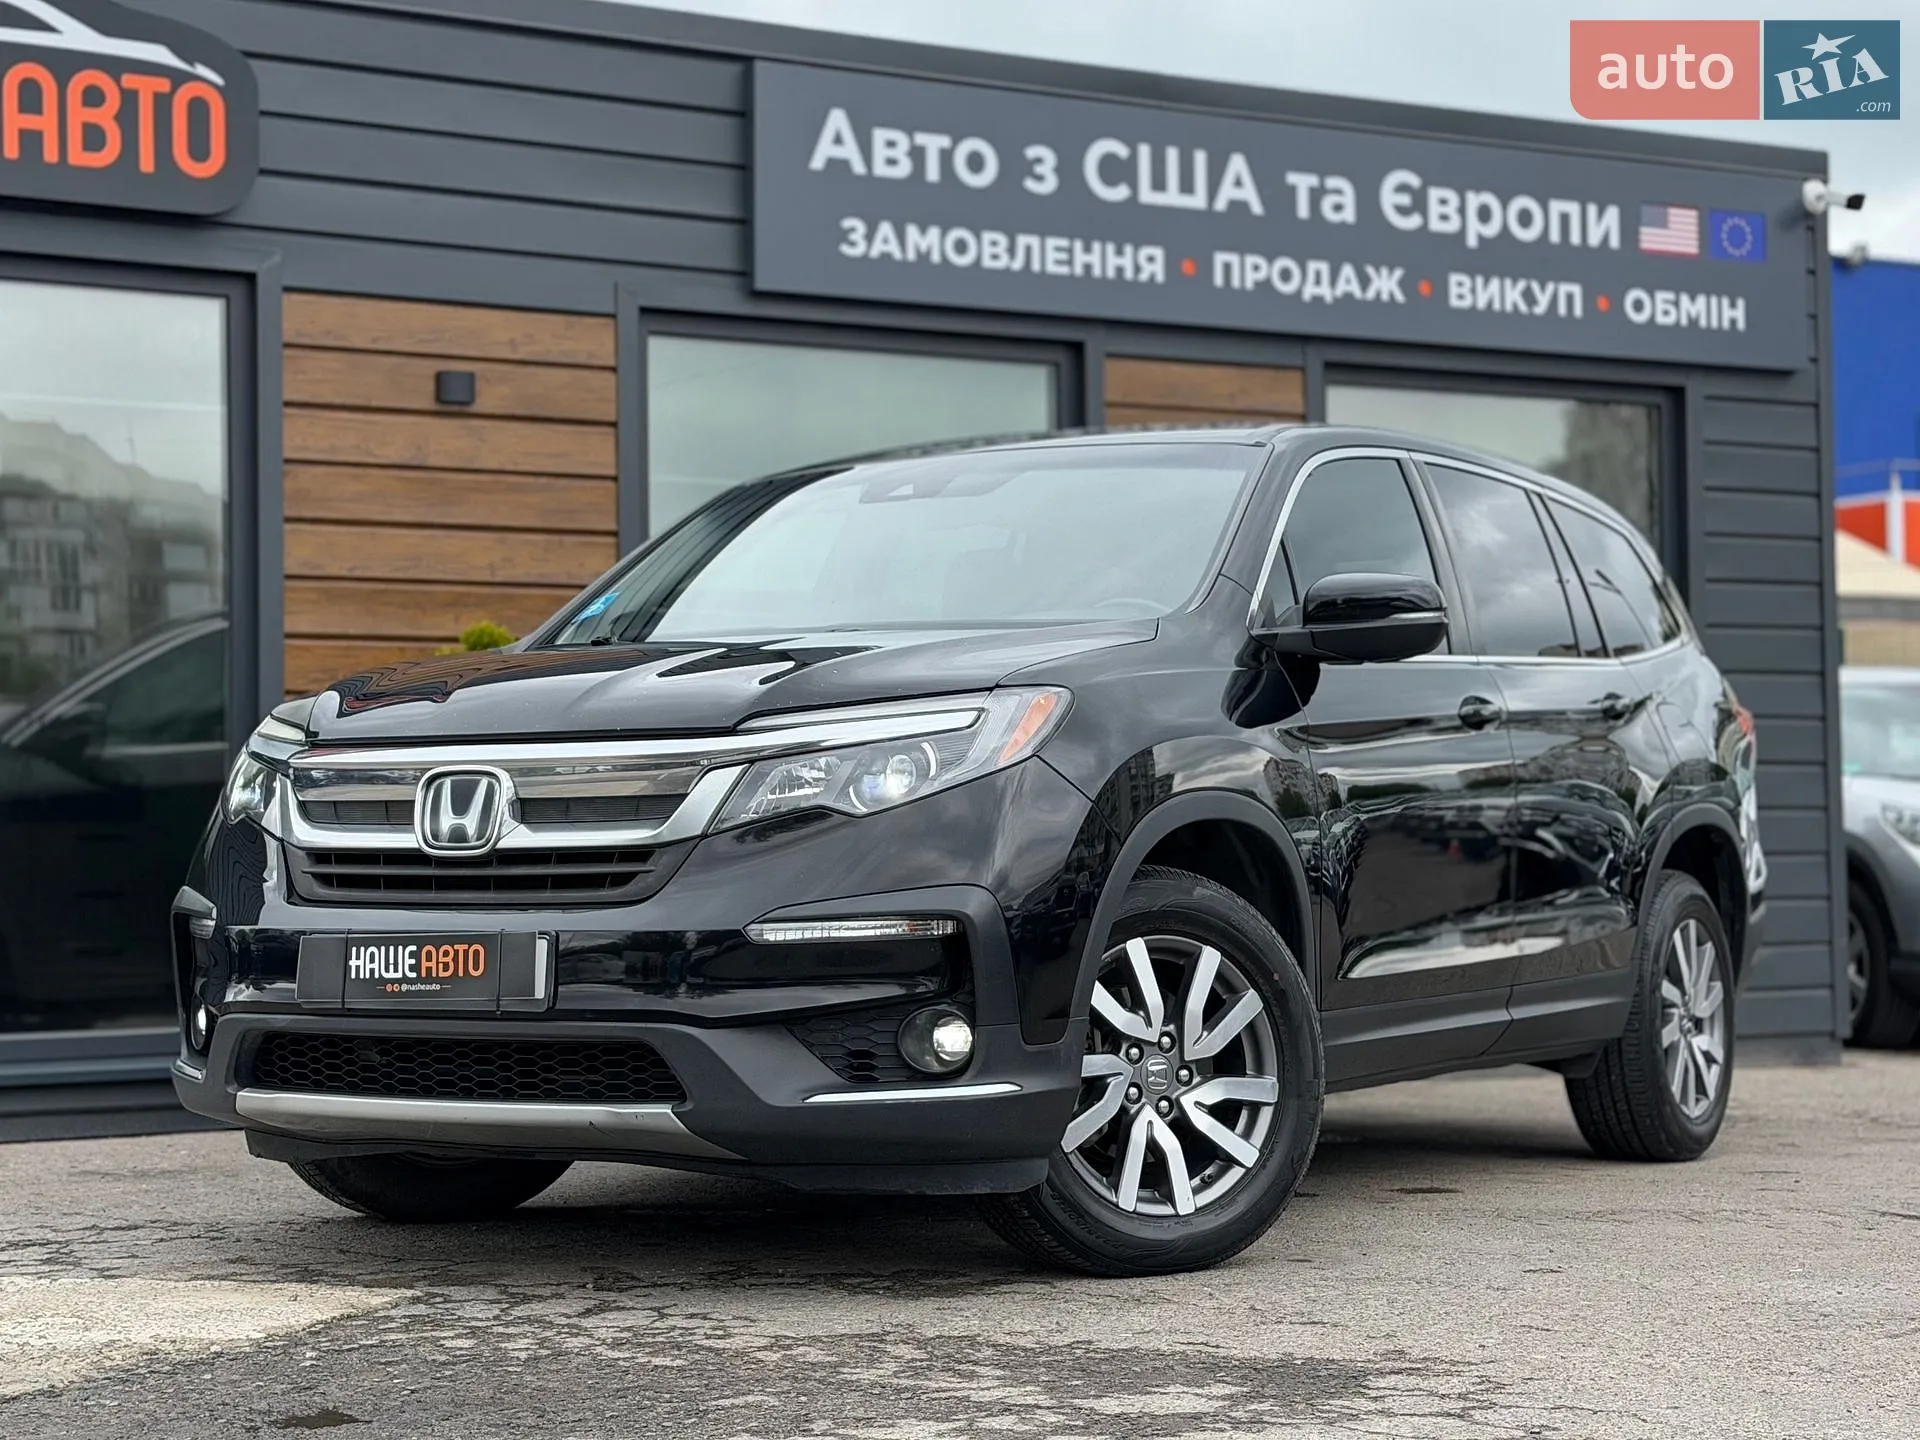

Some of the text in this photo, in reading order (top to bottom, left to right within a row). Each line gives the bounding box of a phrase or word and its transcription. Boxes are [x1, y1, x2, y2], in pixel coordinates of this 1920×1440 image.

[2, 61, 227, 179] АВТО
[808, 106, 1622, 251] Авто з США та Європи
[838, 216, 1747, 333] ЗАМОВЛЕННЯ ПРОДАЖ ВИКУП ОБМІН
[348, 943, 486, 980] НАШЕ АВТО
[400, 983, 441, 992] @nasheauto
